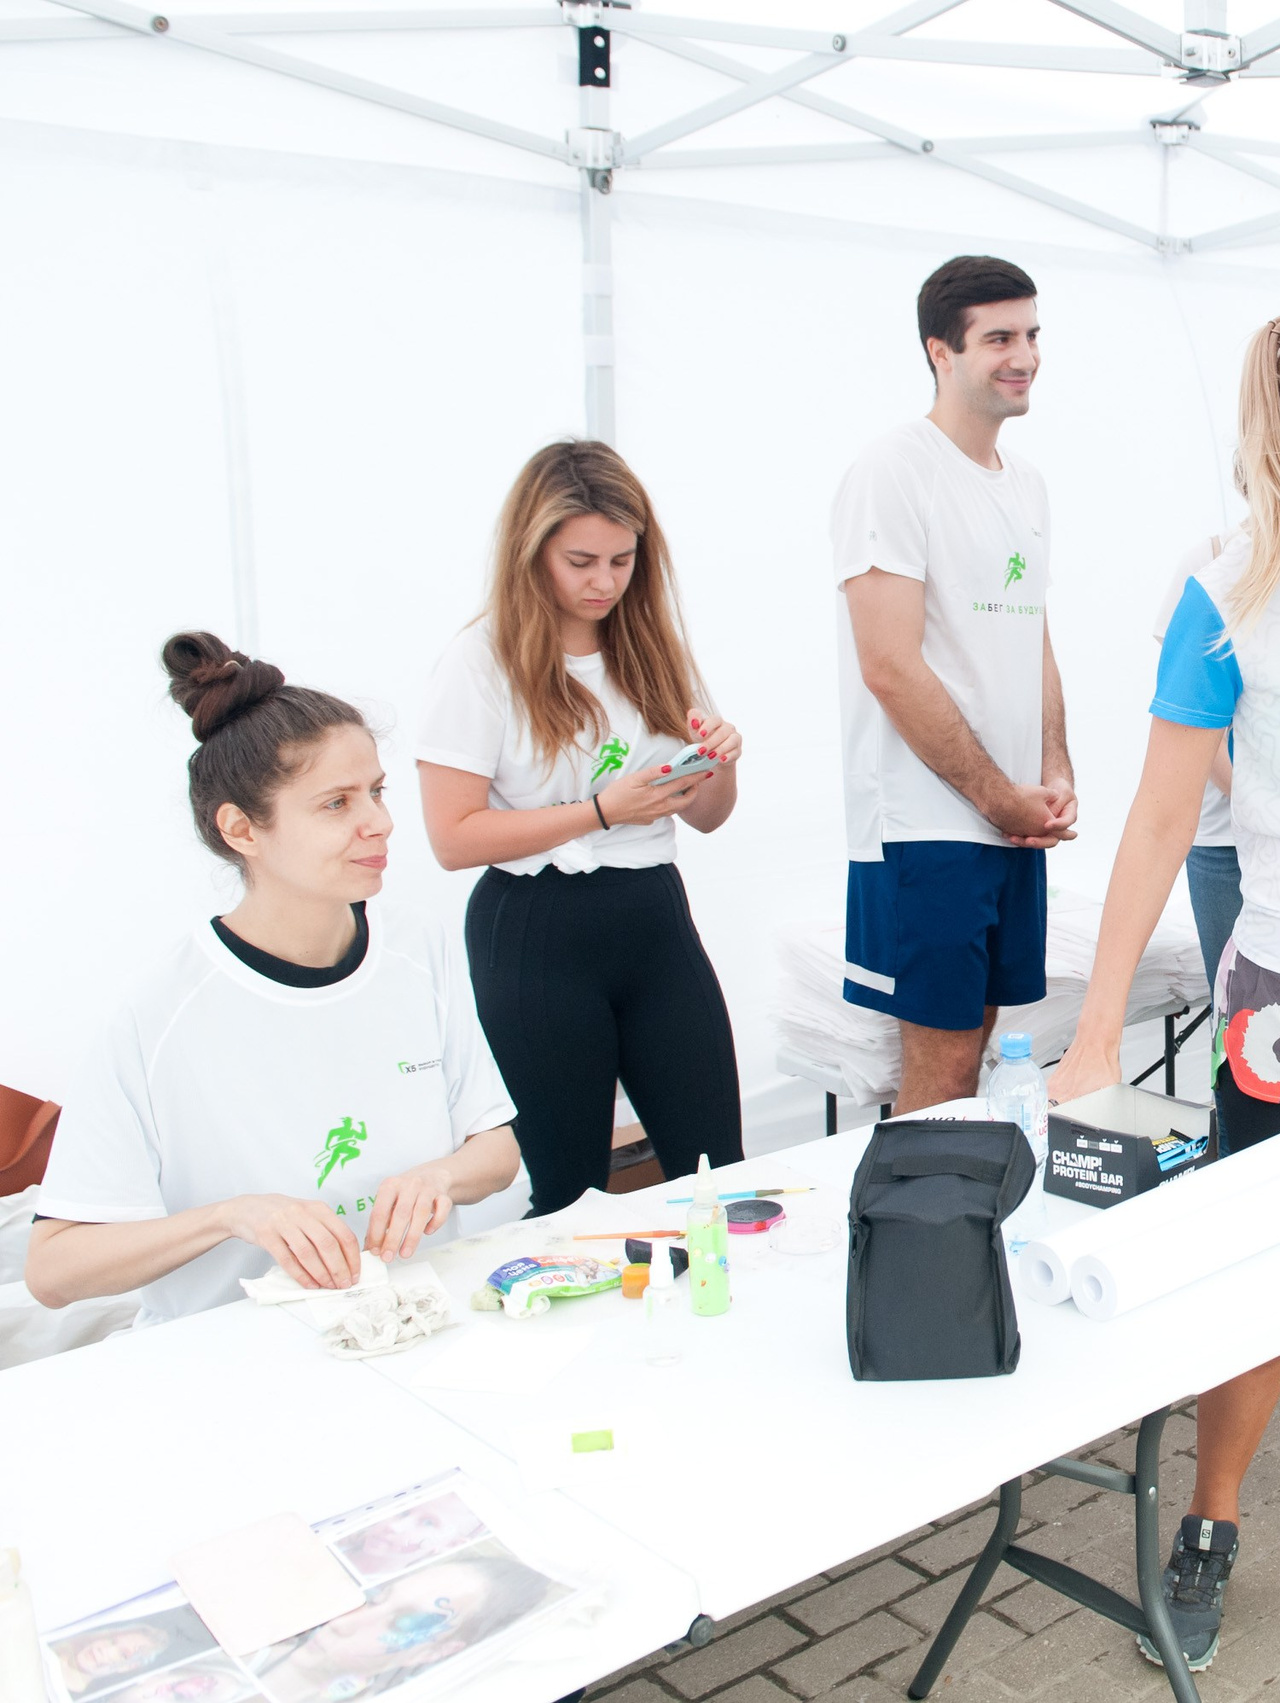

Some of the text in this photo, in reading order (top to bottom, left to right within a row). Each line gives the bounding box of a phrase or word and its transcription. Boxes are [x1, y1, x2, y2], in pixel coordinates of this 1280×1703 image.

[973, 602, 1043, 615] ЗАБЕГ ЗА БУДУ
[1052, 1150, 1102, 1171] CHAMP!
[1052, 1164, 1124, 1186] PROTEIN BAR
